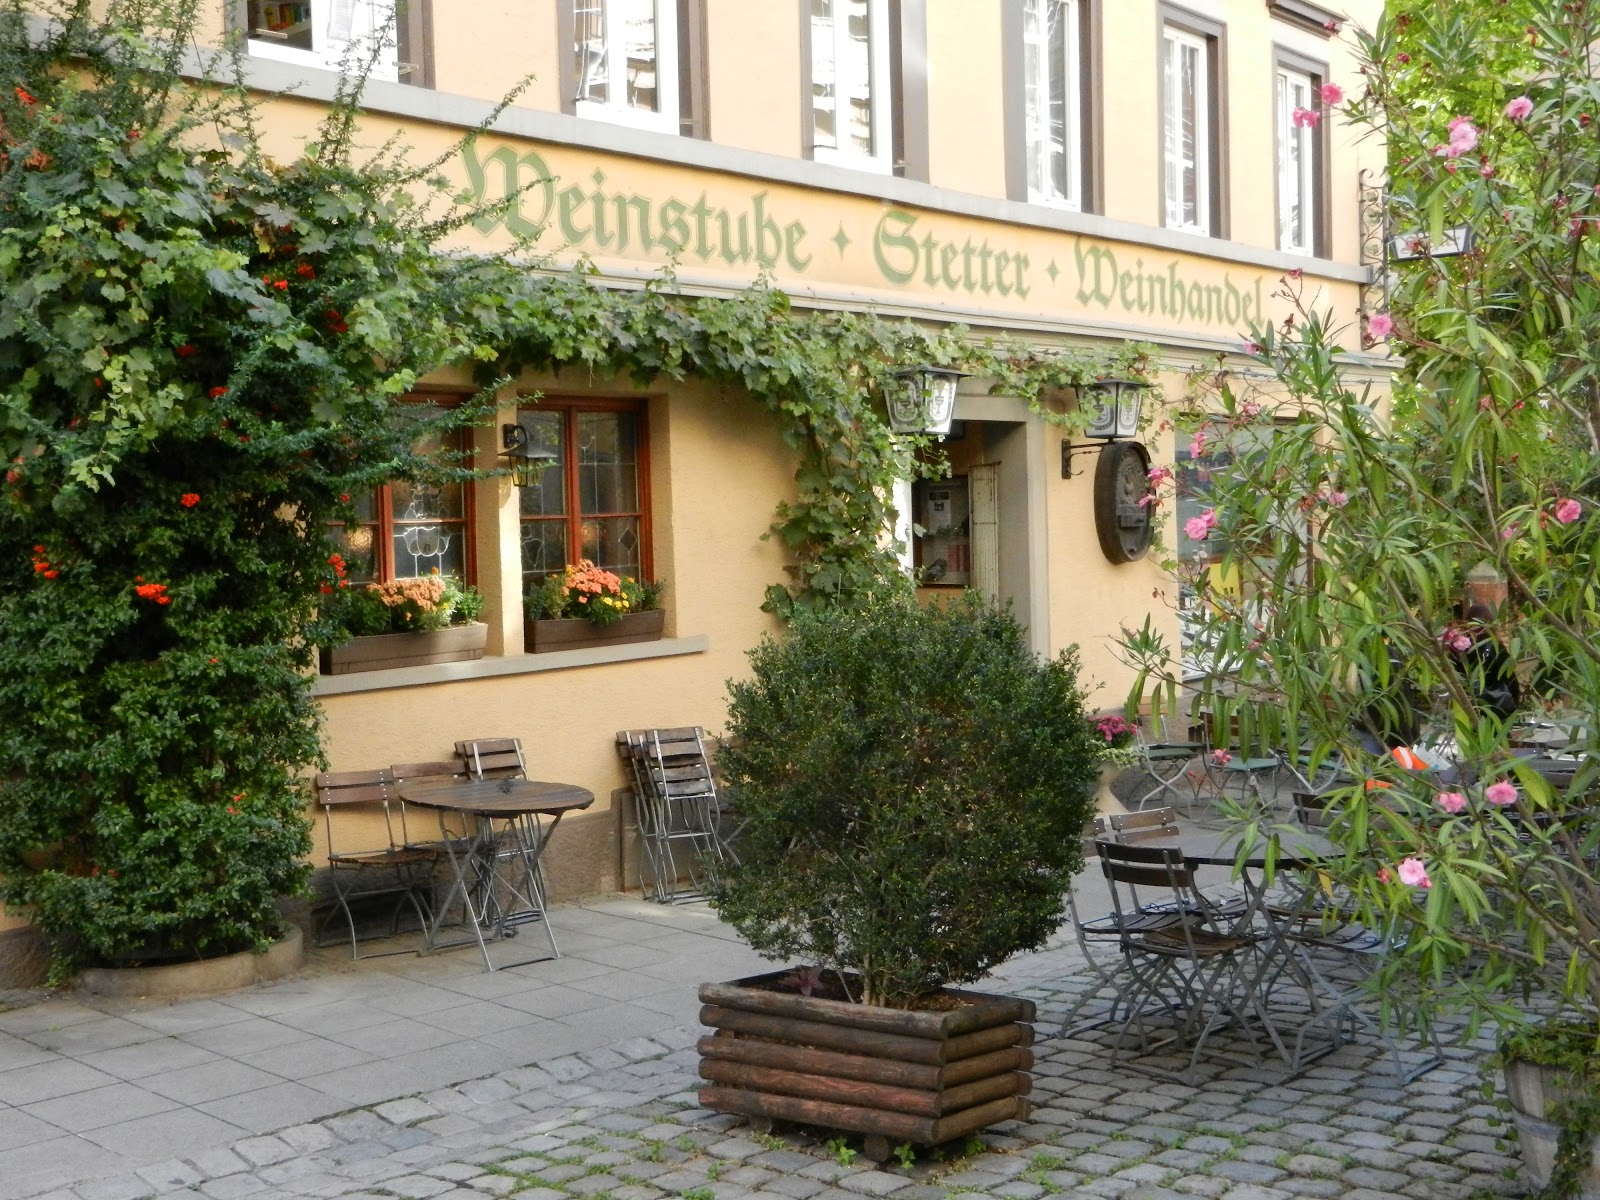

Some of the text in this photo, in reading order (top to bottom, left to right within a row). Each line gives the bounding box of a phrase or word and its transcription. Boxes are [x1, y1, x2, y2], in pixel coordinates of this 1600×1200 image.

[461, 139, 1266, 329] Weinstube Stetter Weinhandel
